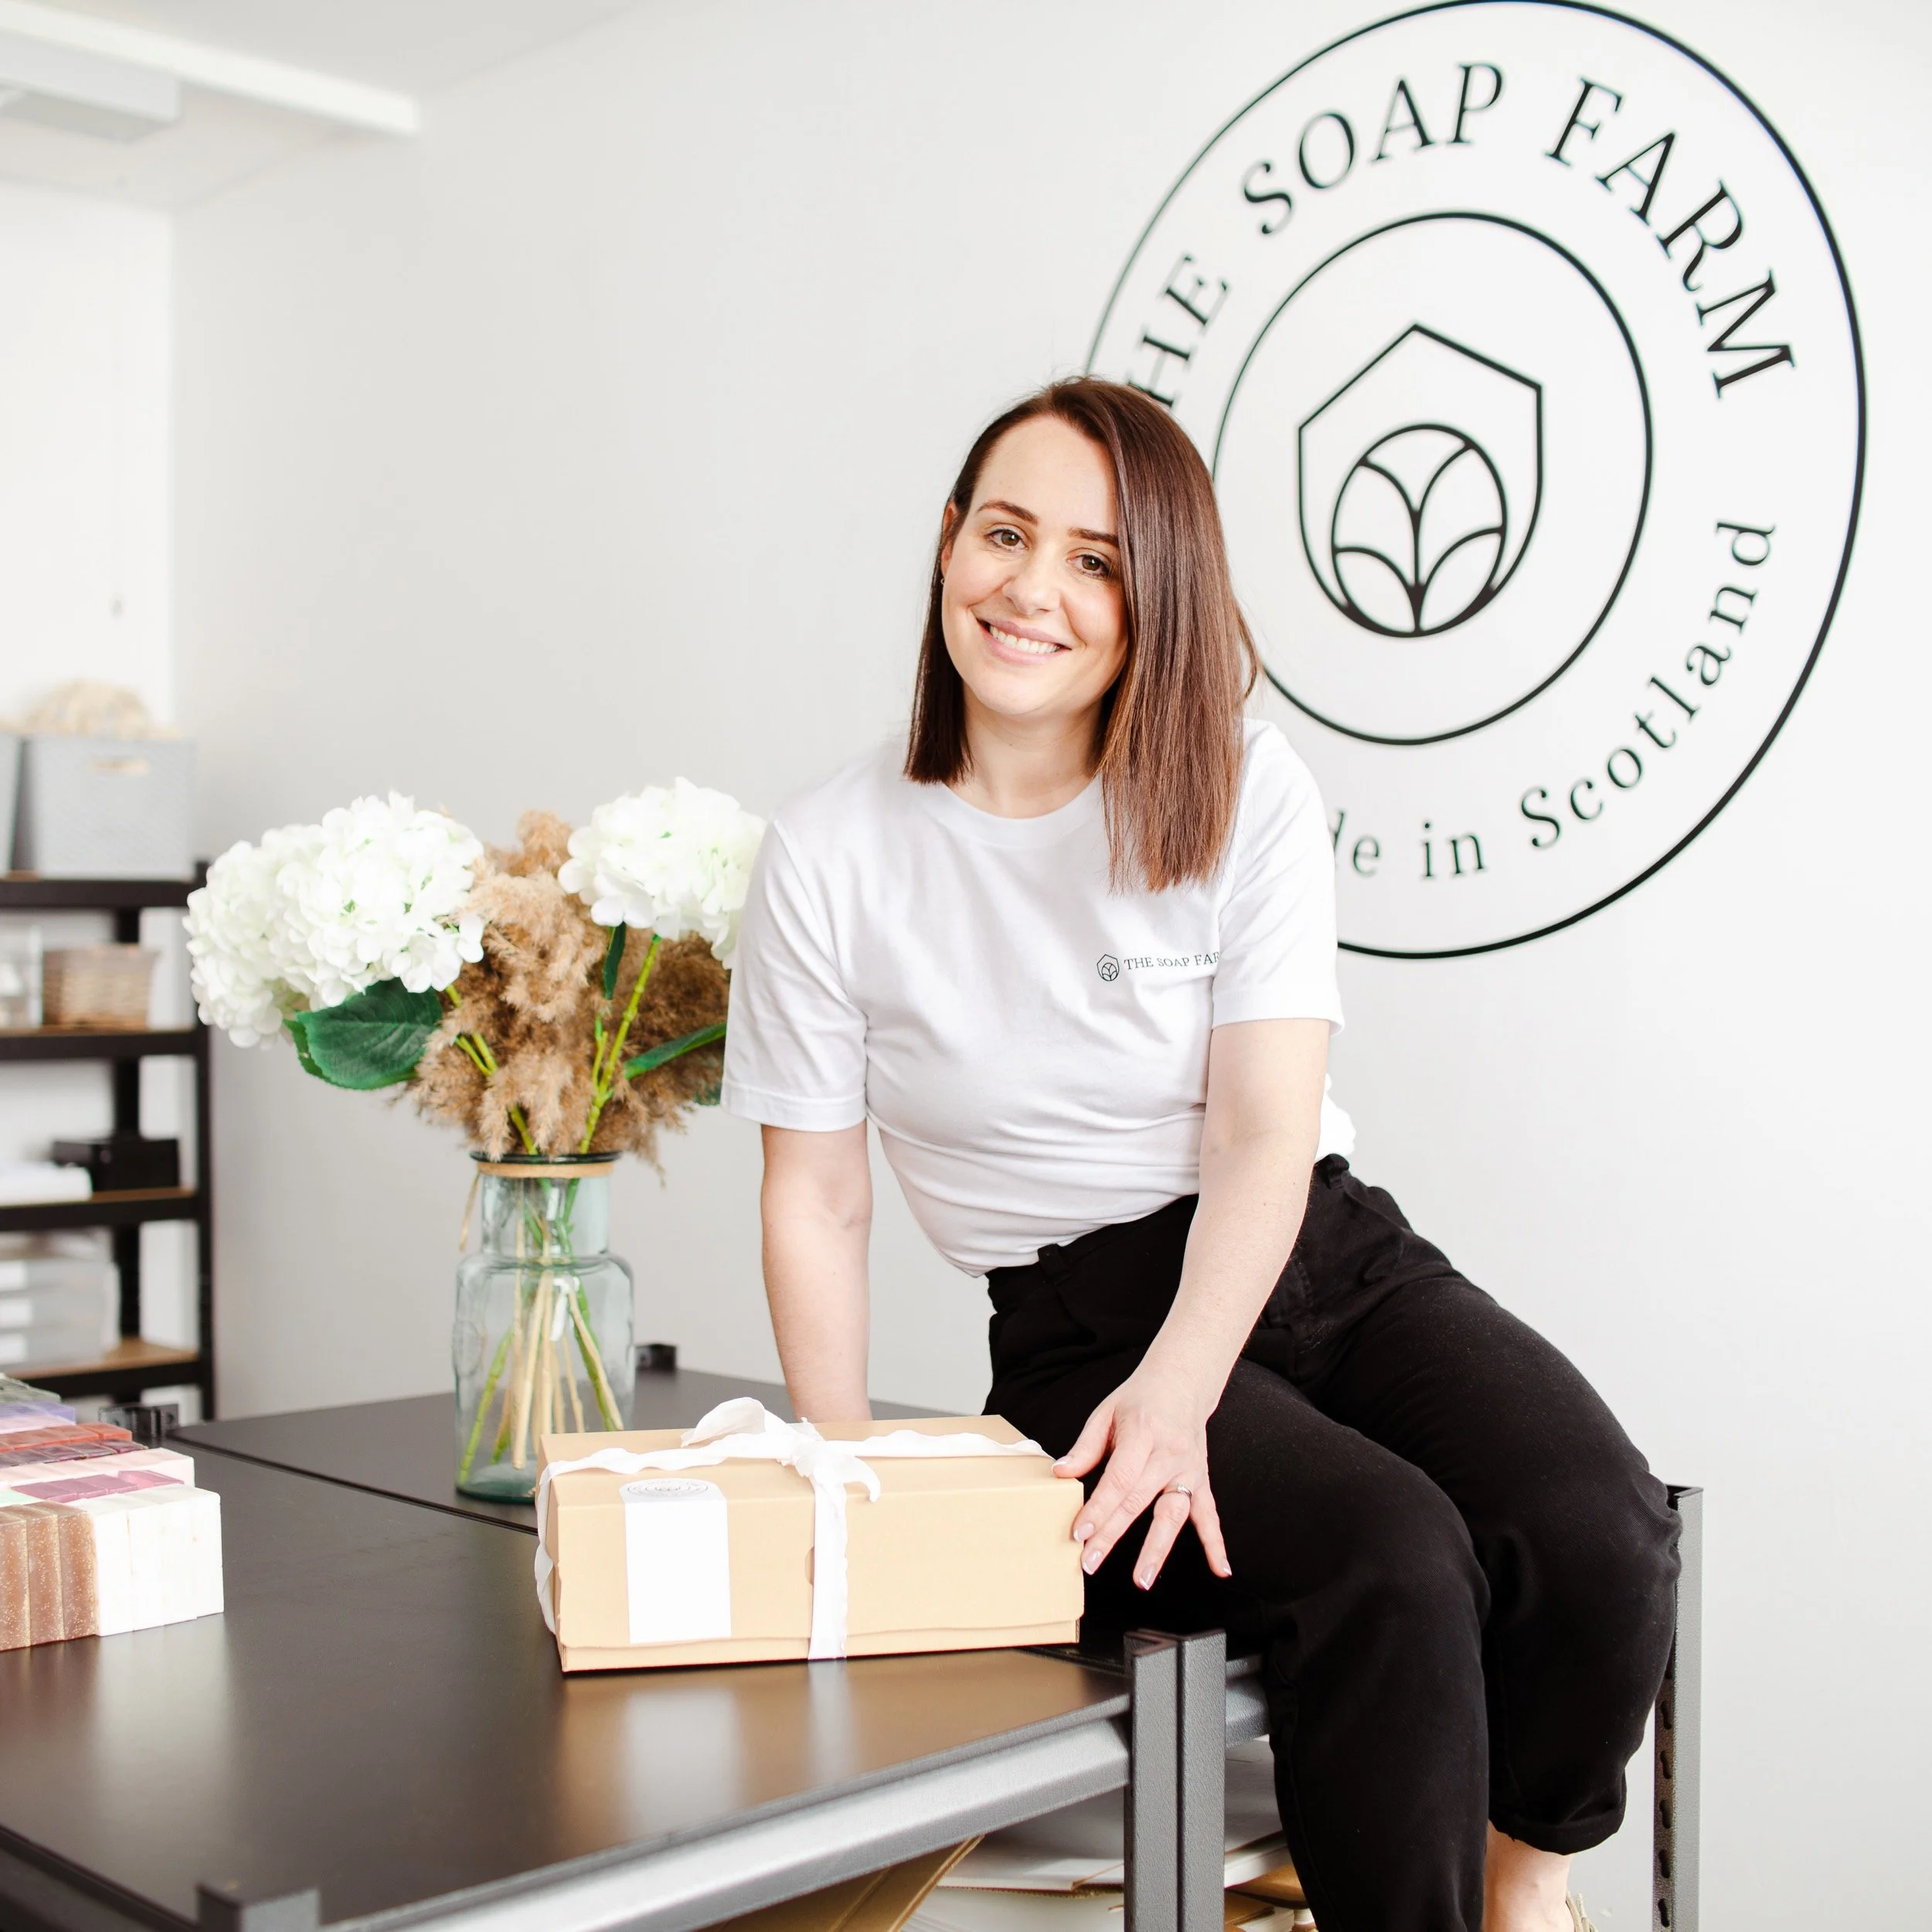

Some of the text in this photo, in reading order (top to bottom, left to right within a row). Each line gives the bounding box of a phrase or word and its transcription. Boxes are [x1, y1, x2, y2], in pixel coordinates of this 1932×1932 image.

[1125, 63, 1796, 407] HE SOAP FARM
[1420, 520, 1776, 880] in Scotland
[1124, 951, 1219, 971] THE SOAP FAR
